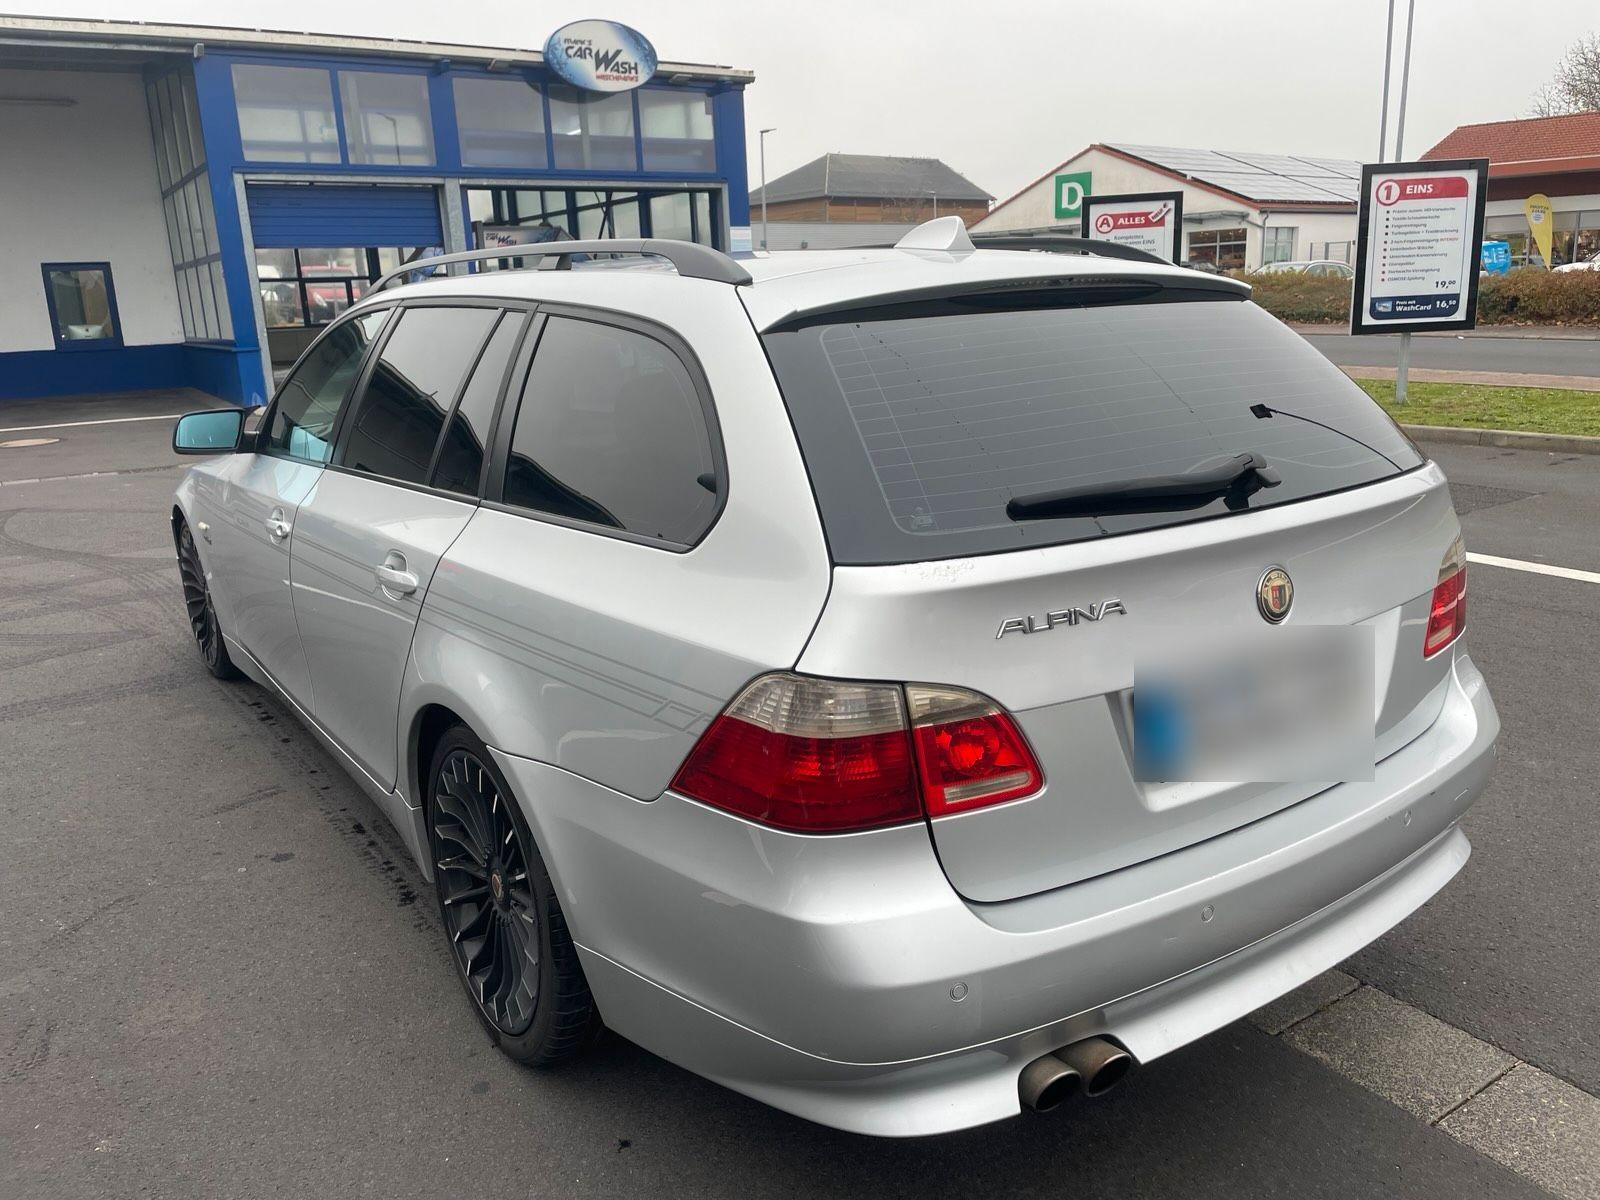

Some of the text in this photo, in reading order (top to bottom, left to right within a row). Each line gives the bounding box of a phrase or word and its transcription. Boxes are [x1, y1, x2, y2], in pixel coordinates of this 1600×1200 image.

[565, 45, 638, 74] CAR WASH
[1062, 182, 1084, 210] D
[1384, 185, 1393, 201] 1
[1407, 185, 1433, 195] EINS
[1099, 216, 1145, 229] A ALLES
[1435, 280, 1456, 289] 19,00
[1396, 304, 1432, 312] WashCard
[1435, 300, 1456, 309] 16,50
[995, 597, 1128, 640] ALPINA
